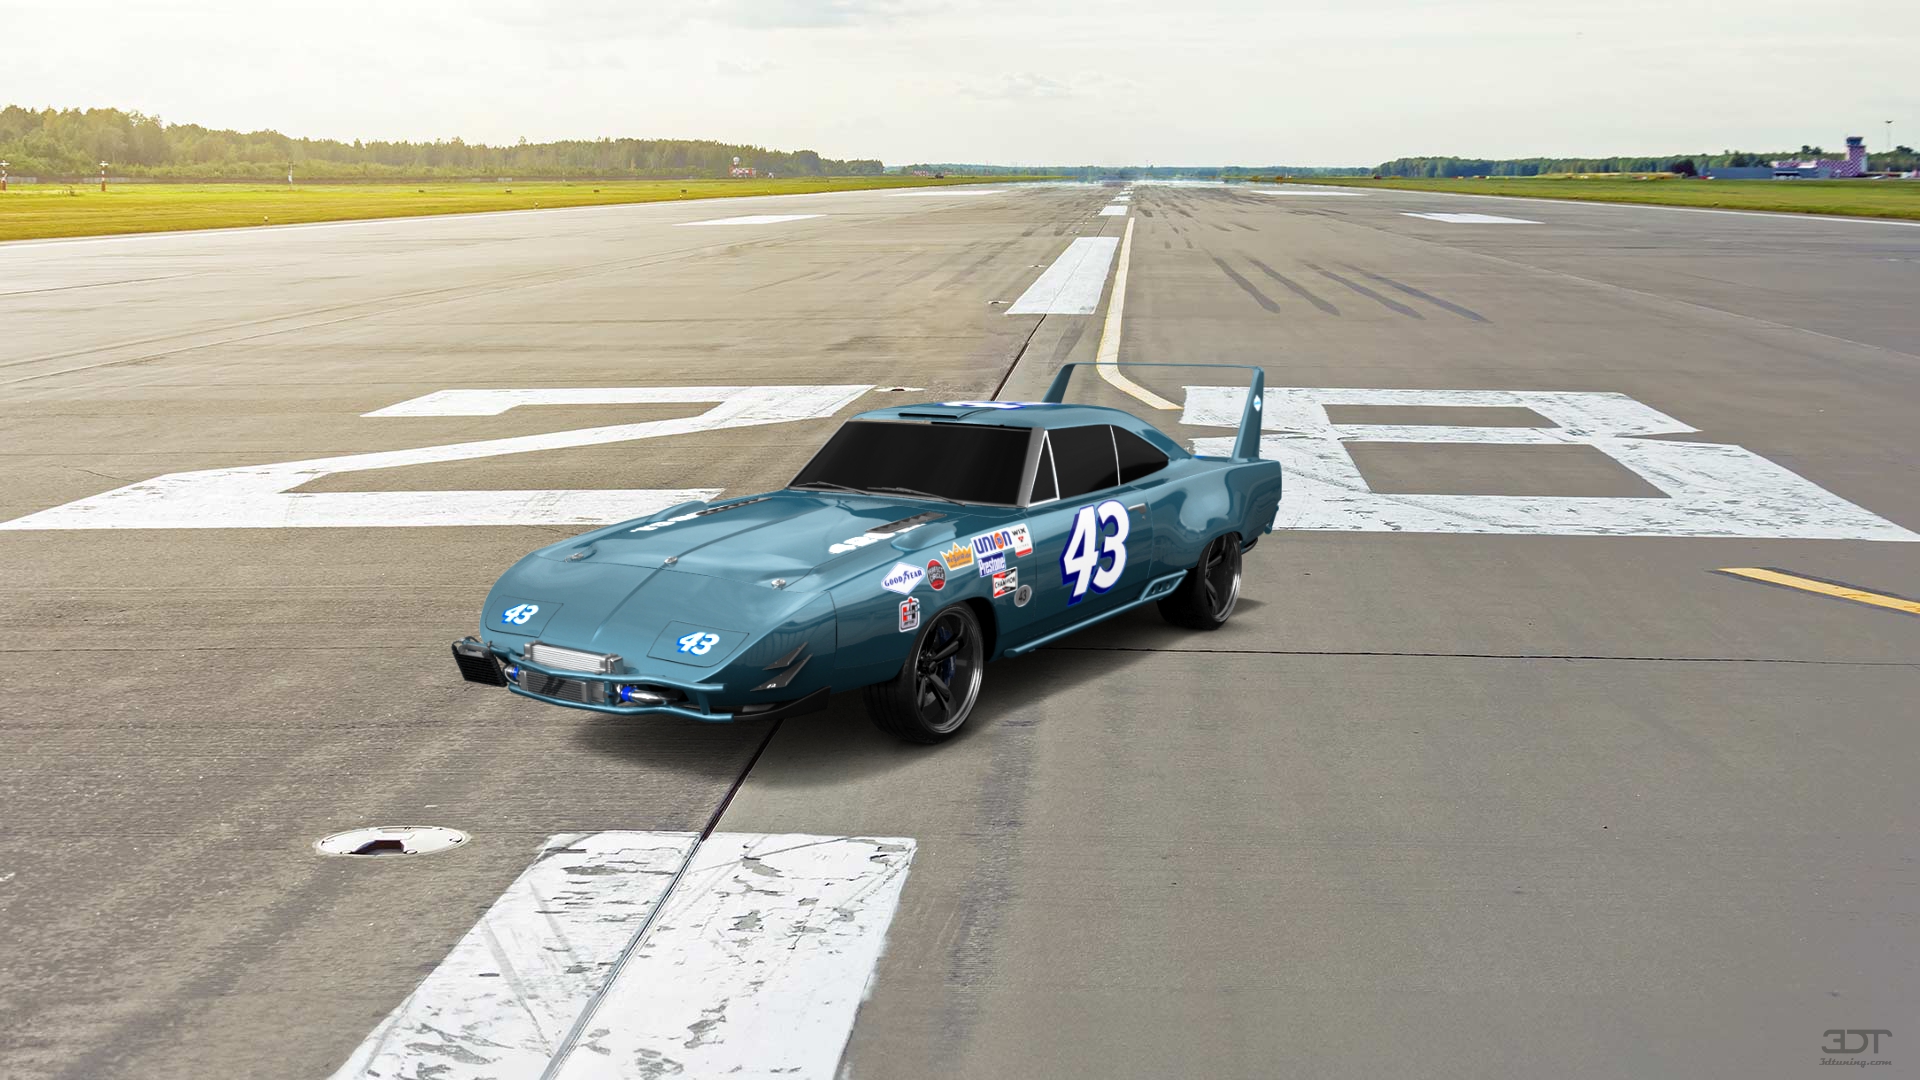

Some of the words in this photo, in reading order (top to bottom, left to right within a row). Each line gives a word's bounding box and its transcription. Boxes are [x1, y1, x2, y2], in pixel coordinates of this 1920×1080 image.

[1060, 500, 1130, 605] 43
[1018, 589, 1027, 602] 43
[501, 603, 540, 625] 43
[676, 631, 721, 656] 43
